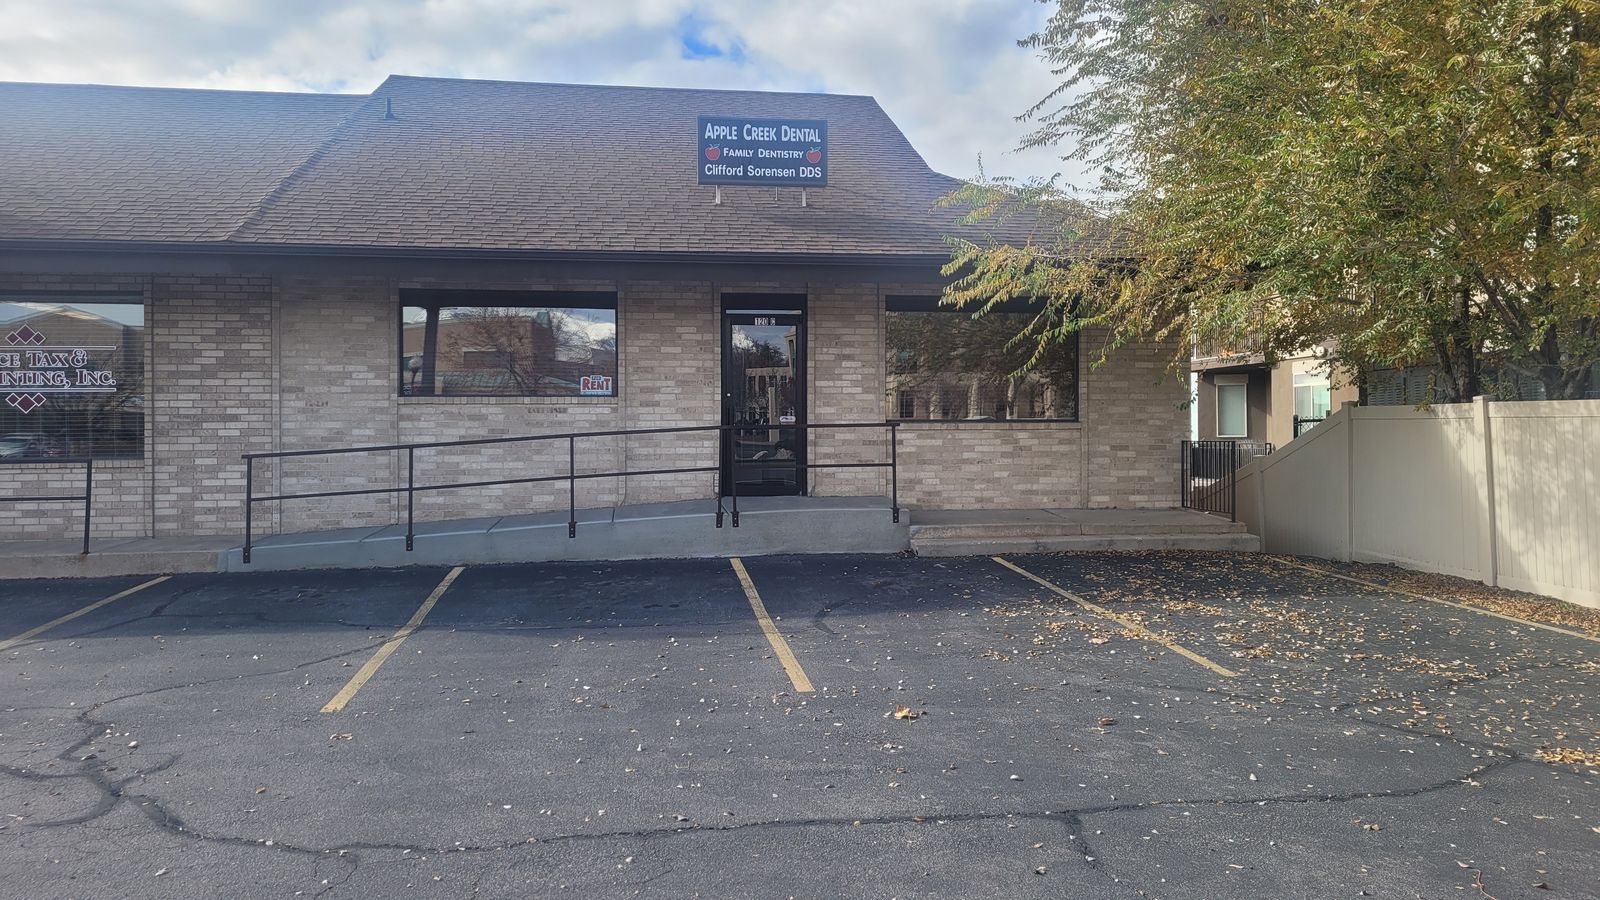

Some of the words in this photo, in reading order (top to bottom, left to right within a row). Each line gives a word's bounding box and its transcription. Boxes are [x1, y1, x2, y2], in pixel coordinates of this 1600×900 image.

[704, 122, 738, 140] APPLE
[743, 123, 777, 142] CREEK
[781, 125, 821, 143] DENTAL
[723, 147, 754, 158] FAMILY
[758, 148, 804, 159] DENTISTRY
[704, 163, 743, 176] Clifford
[747, 165, 795, 177] Sorensen
[799, 166, 822, 178] DDS
[755, 317, 768, 326] 120
[26, 350, 69, 368] TAX
[76, 369, 117, 385] INC.
[582, 377, 611, 391] RENT
